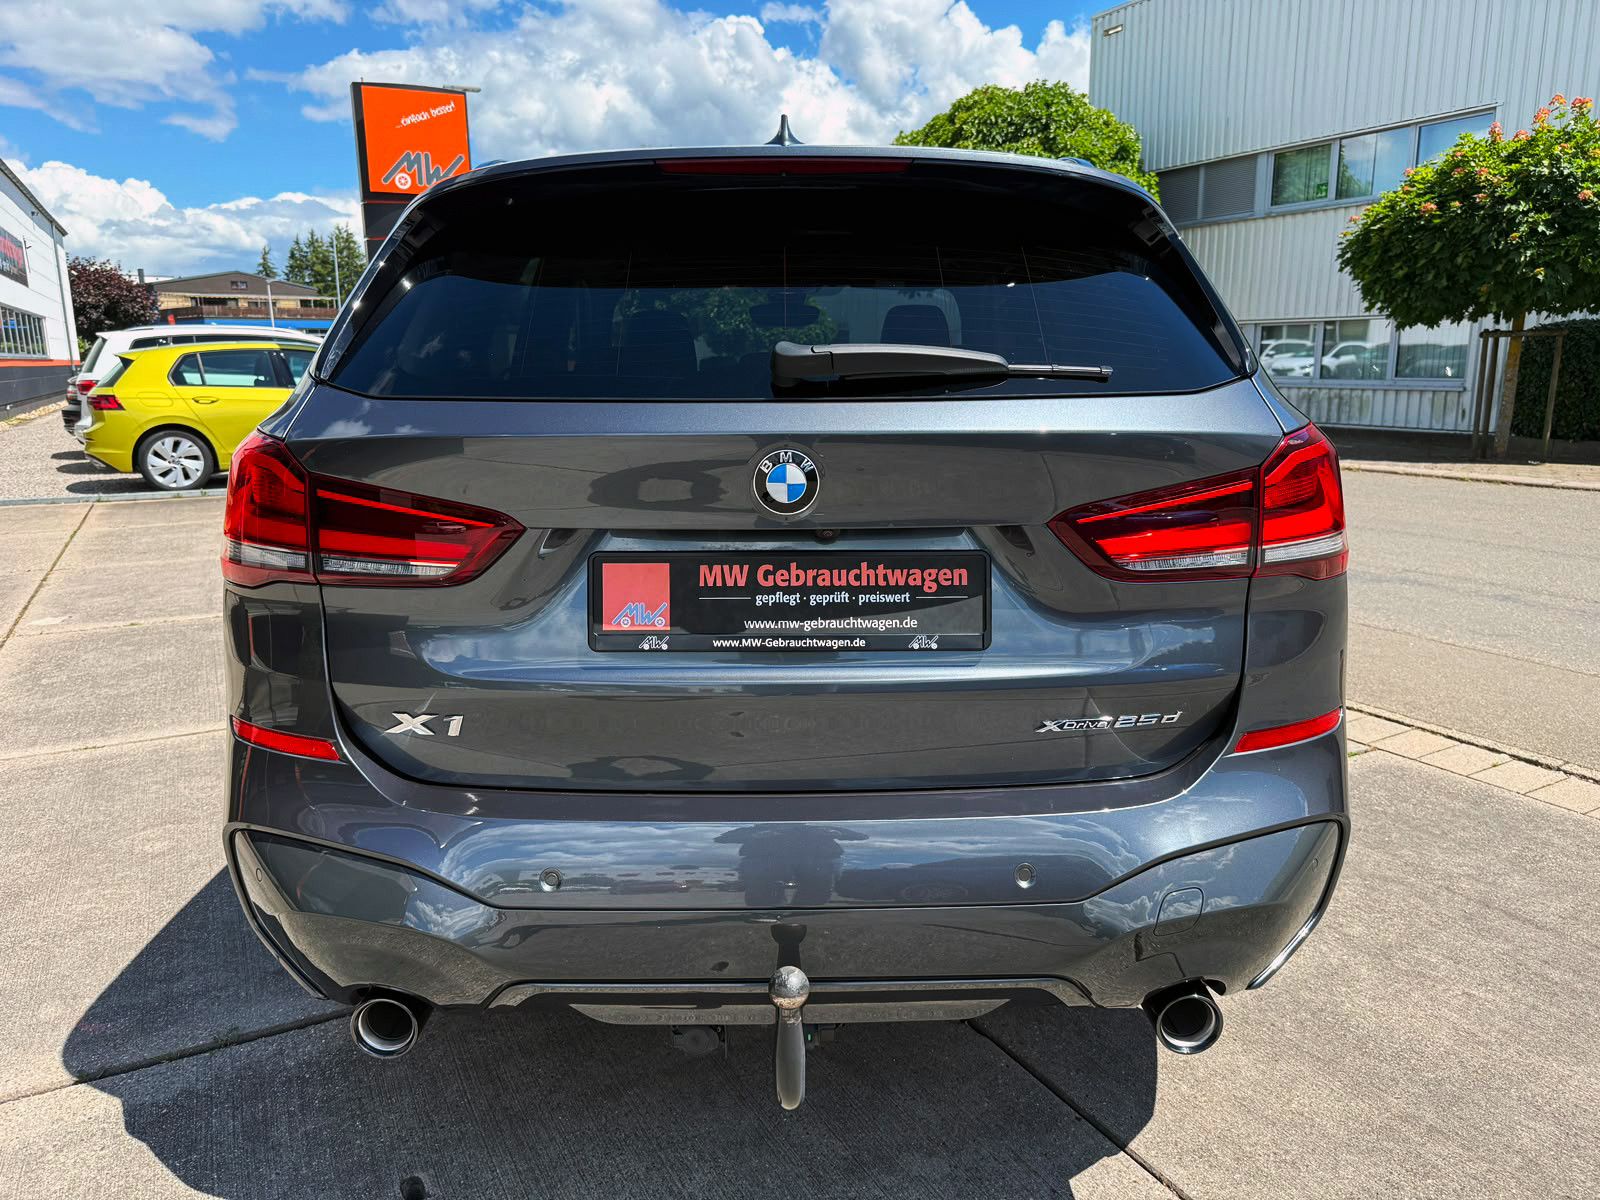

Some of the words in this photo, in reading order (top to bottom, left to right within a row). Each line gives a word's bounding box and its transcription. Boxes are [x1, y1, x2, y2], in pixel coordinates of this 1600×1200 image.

[381, 150, 465, 187] MW
[760, 451, 814, 474] BMW
[699, 564, 749, 587] MW
[756, 562, 968, 593] Gebrauchtwagen
[755, 592, 801, 606] gepflegt
[809, 592, 850, 606] geprüft
[858, 591, 910, 605] preiswert
[612, 602, 668, 627] MW
[744, 617, 918, 632] www.mw-gebrauchtwagen.de
[712, 637, 866, 650] www.MW-Gebrauchtwagen.de
[384, 712, 464, 737] X1
